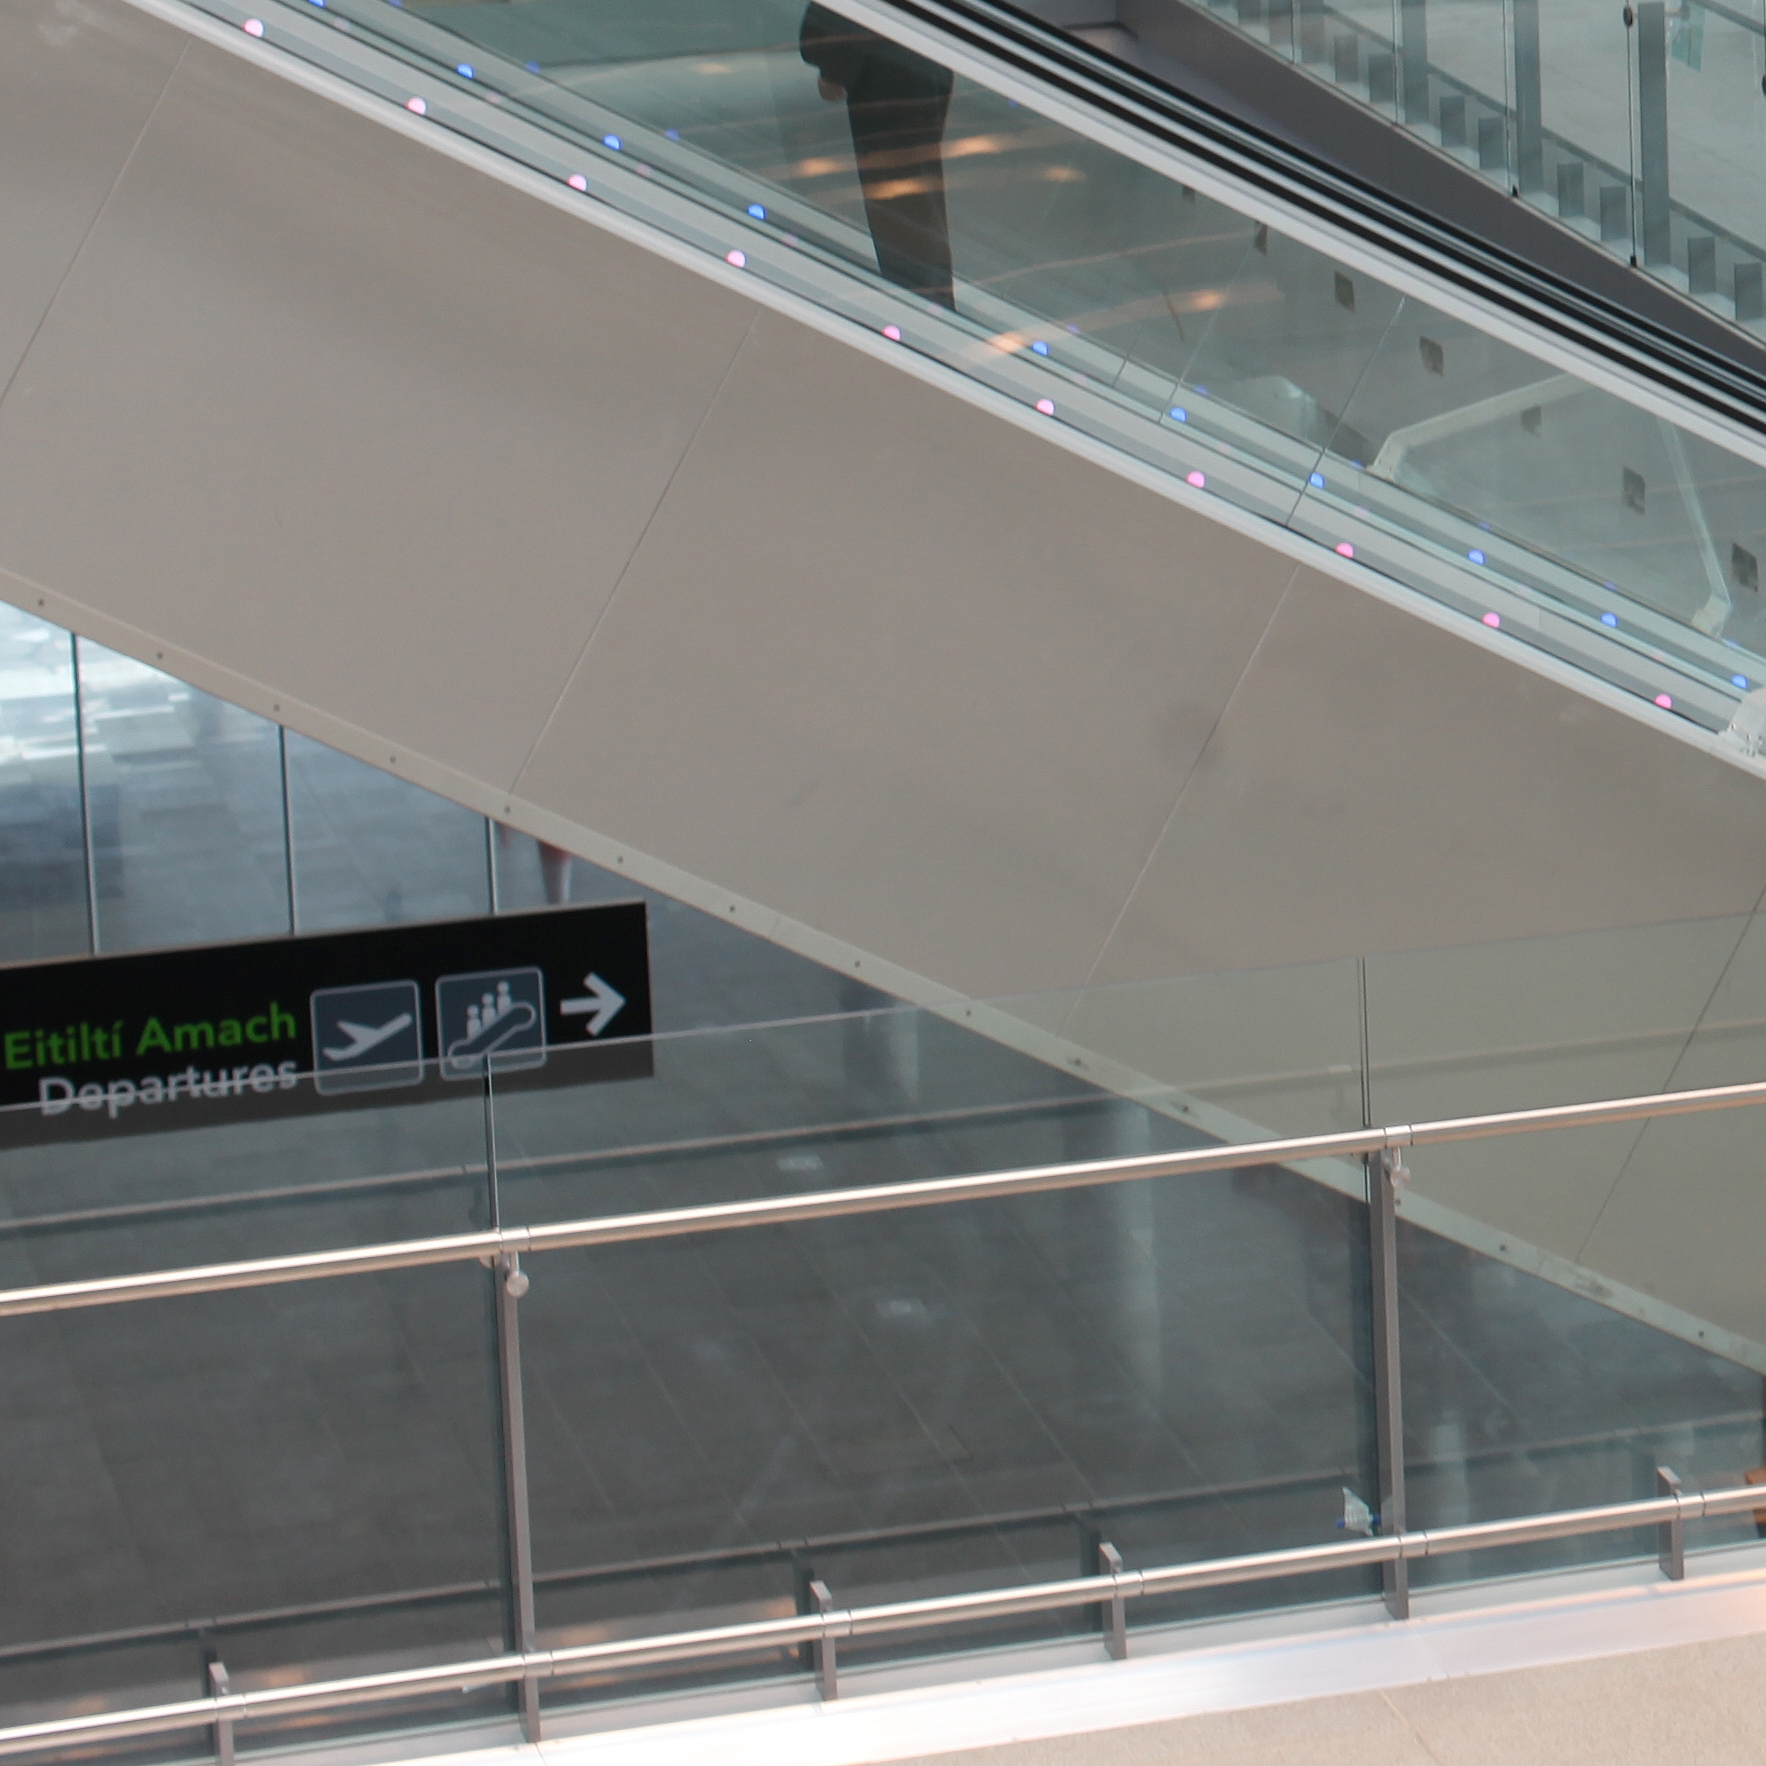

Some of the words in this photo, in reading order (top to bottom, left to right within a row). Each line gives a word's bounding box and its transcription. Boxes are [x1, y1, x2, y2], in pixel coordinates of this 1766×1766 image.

[5, 1016, 122, 1069] Eitiltí
[138, 1002, 297, 1056] Amach
[39, 1058, 299, 1118] Departures
